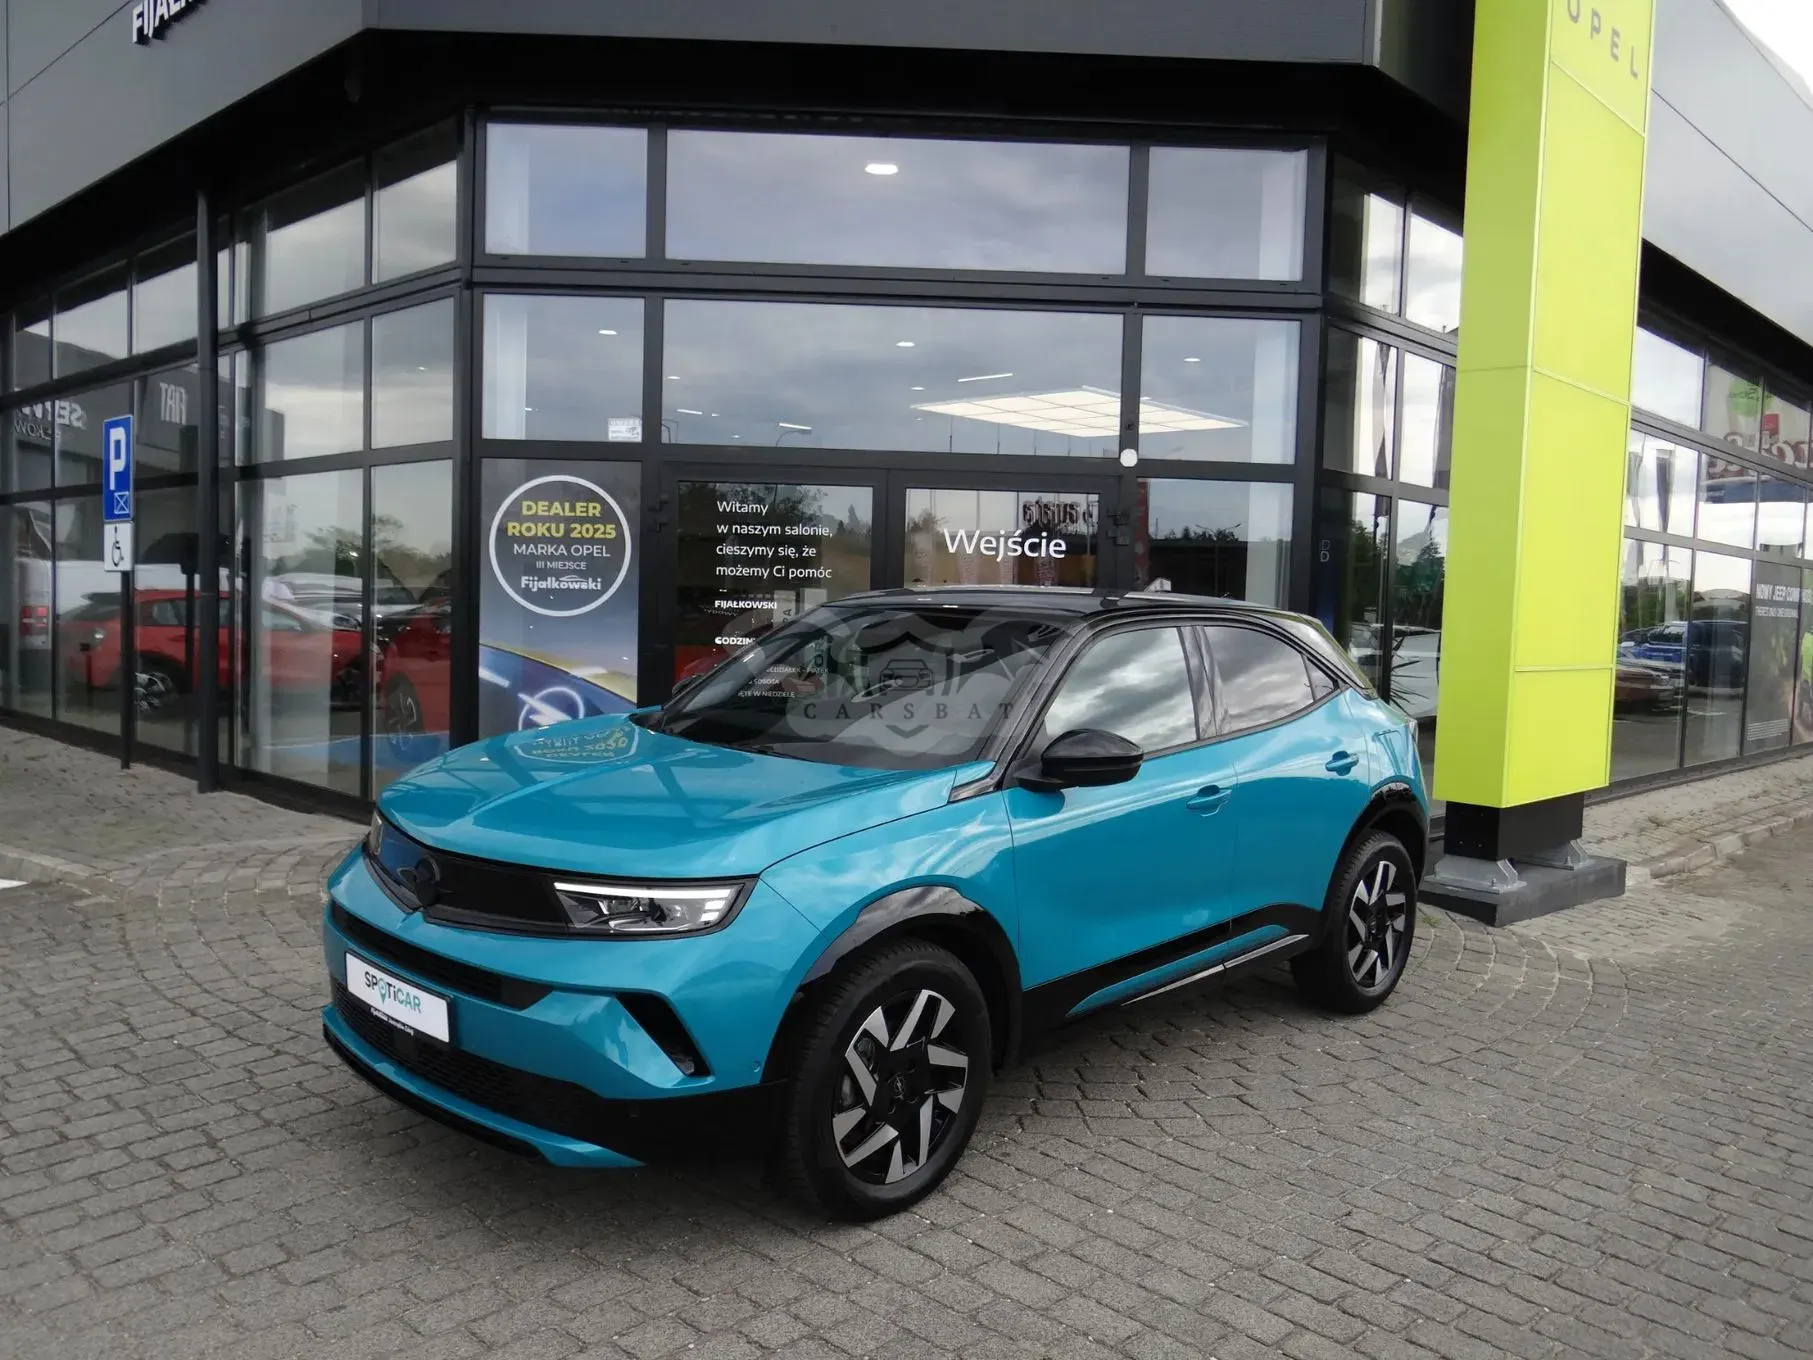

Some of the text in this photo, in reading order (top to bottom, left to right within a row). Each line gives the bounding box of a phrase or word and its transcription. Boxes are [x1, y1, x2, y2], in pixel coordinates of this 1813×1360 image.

[1567, 0, 1639, 80] OPEL
[109, 427, 127, 491] P
[521, 500, 602, 517] DEALER
[716, 500, 769, 516] Witamy
[507, 522, 617, 539] ROKU 2025
[716, 523, 833, 538] w naszym salonie,
[513, 543, 611, 557] MARKA OPEL
[716, 543, 817, 559] cieszymy się, że
[943, 528, 1067, 562] Wejście
[535, 561, 588, 570] III MIEJSCE
[715, 564, 833, 579] możemy Ci pomóc
[714, 600, 777, 610] FIJAŁKOWSKI
[714, 636, 756, 646] GODZIN
